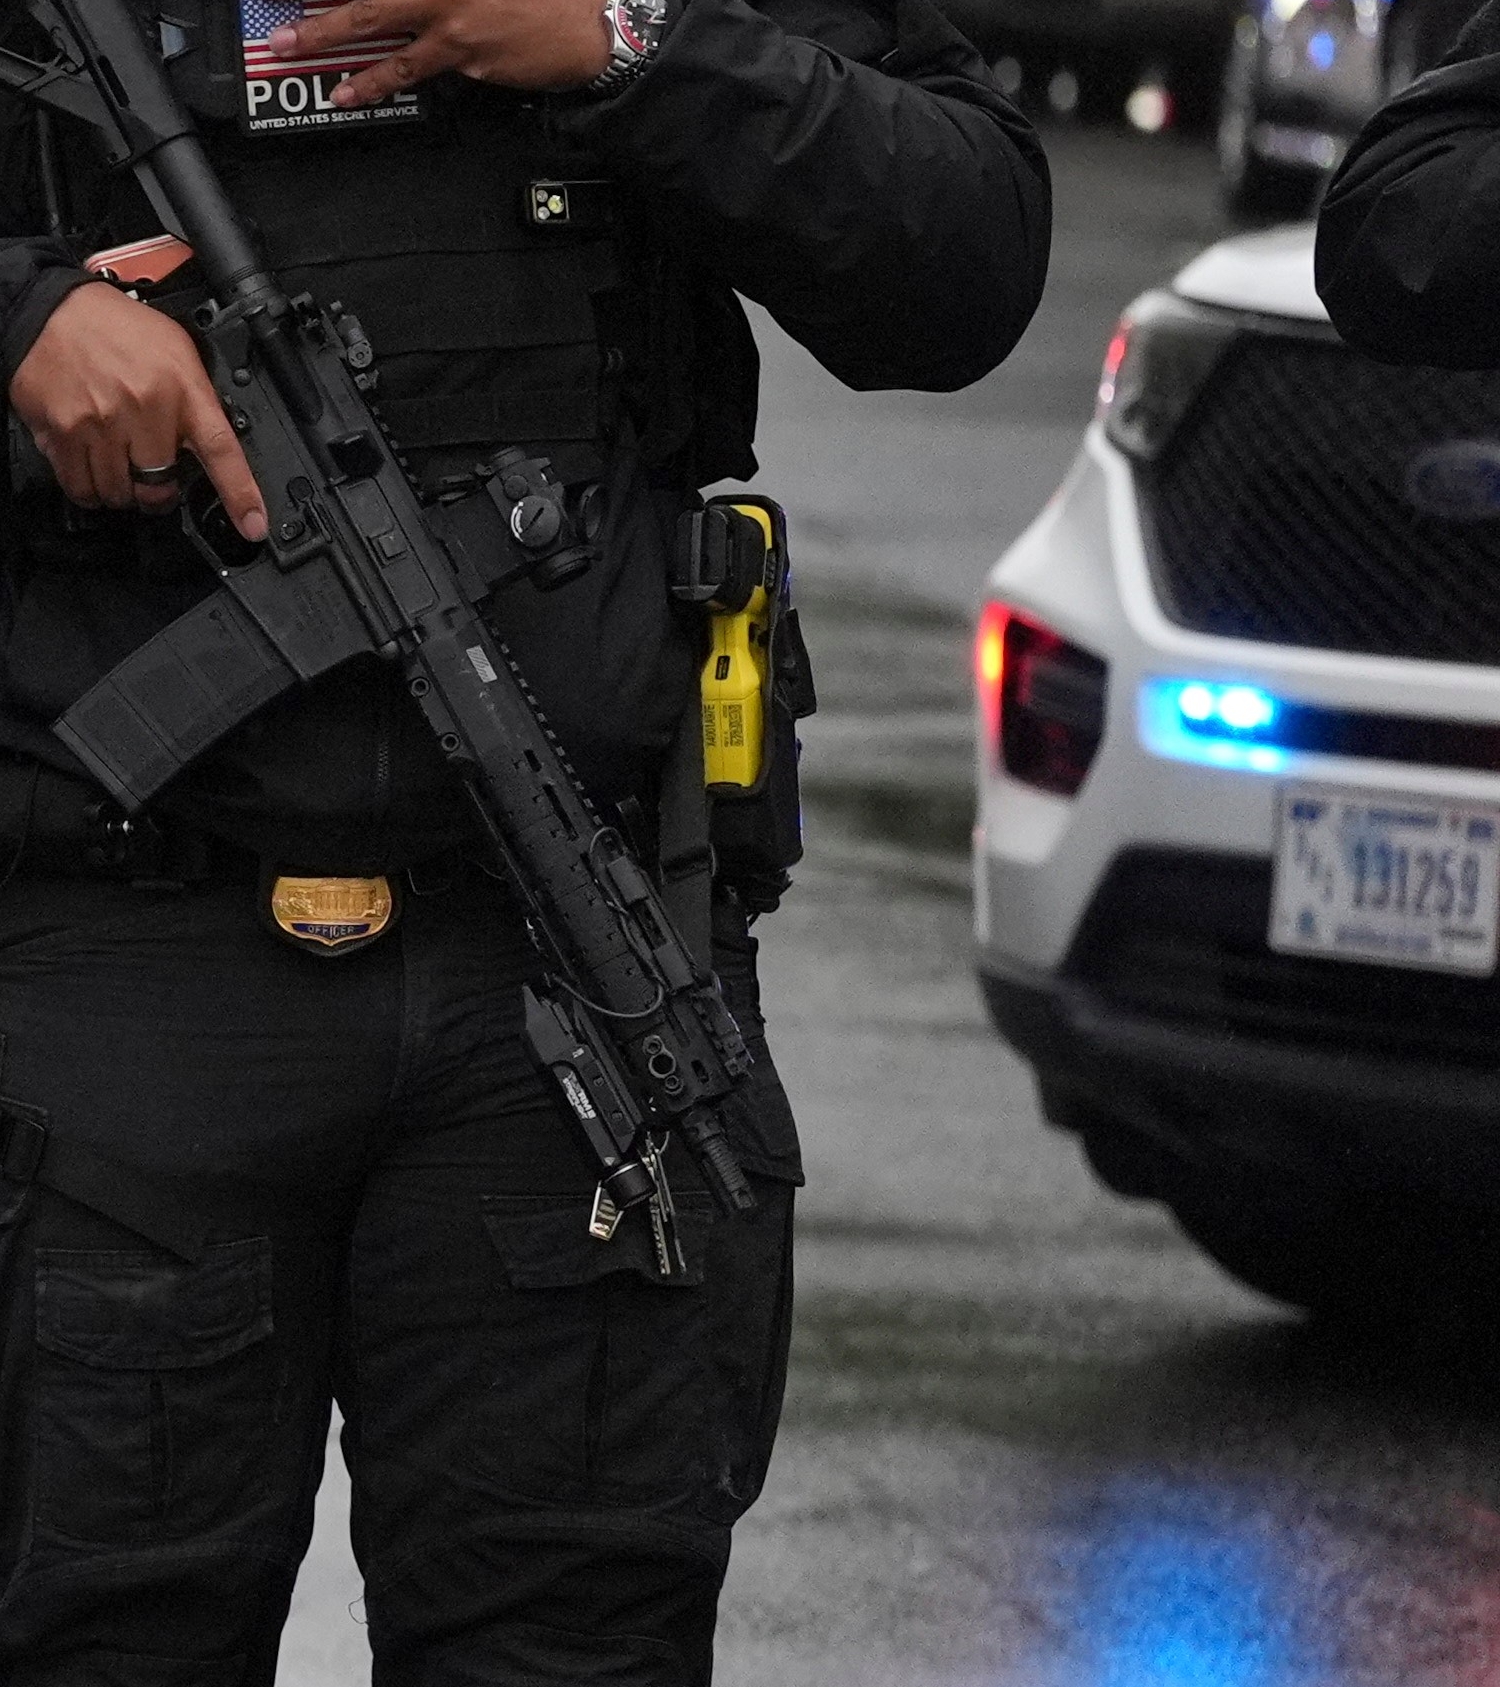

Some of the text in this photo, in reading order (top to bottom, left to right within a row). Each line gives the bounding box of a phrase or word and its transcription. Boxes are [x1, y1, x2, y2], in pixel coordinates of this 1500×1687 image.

[246, 72, 417, 116] POL
[250, 106, 418, 130] UNITED STATES SECRET SERVICE
[307, 925, 355, 938] OFFICER
